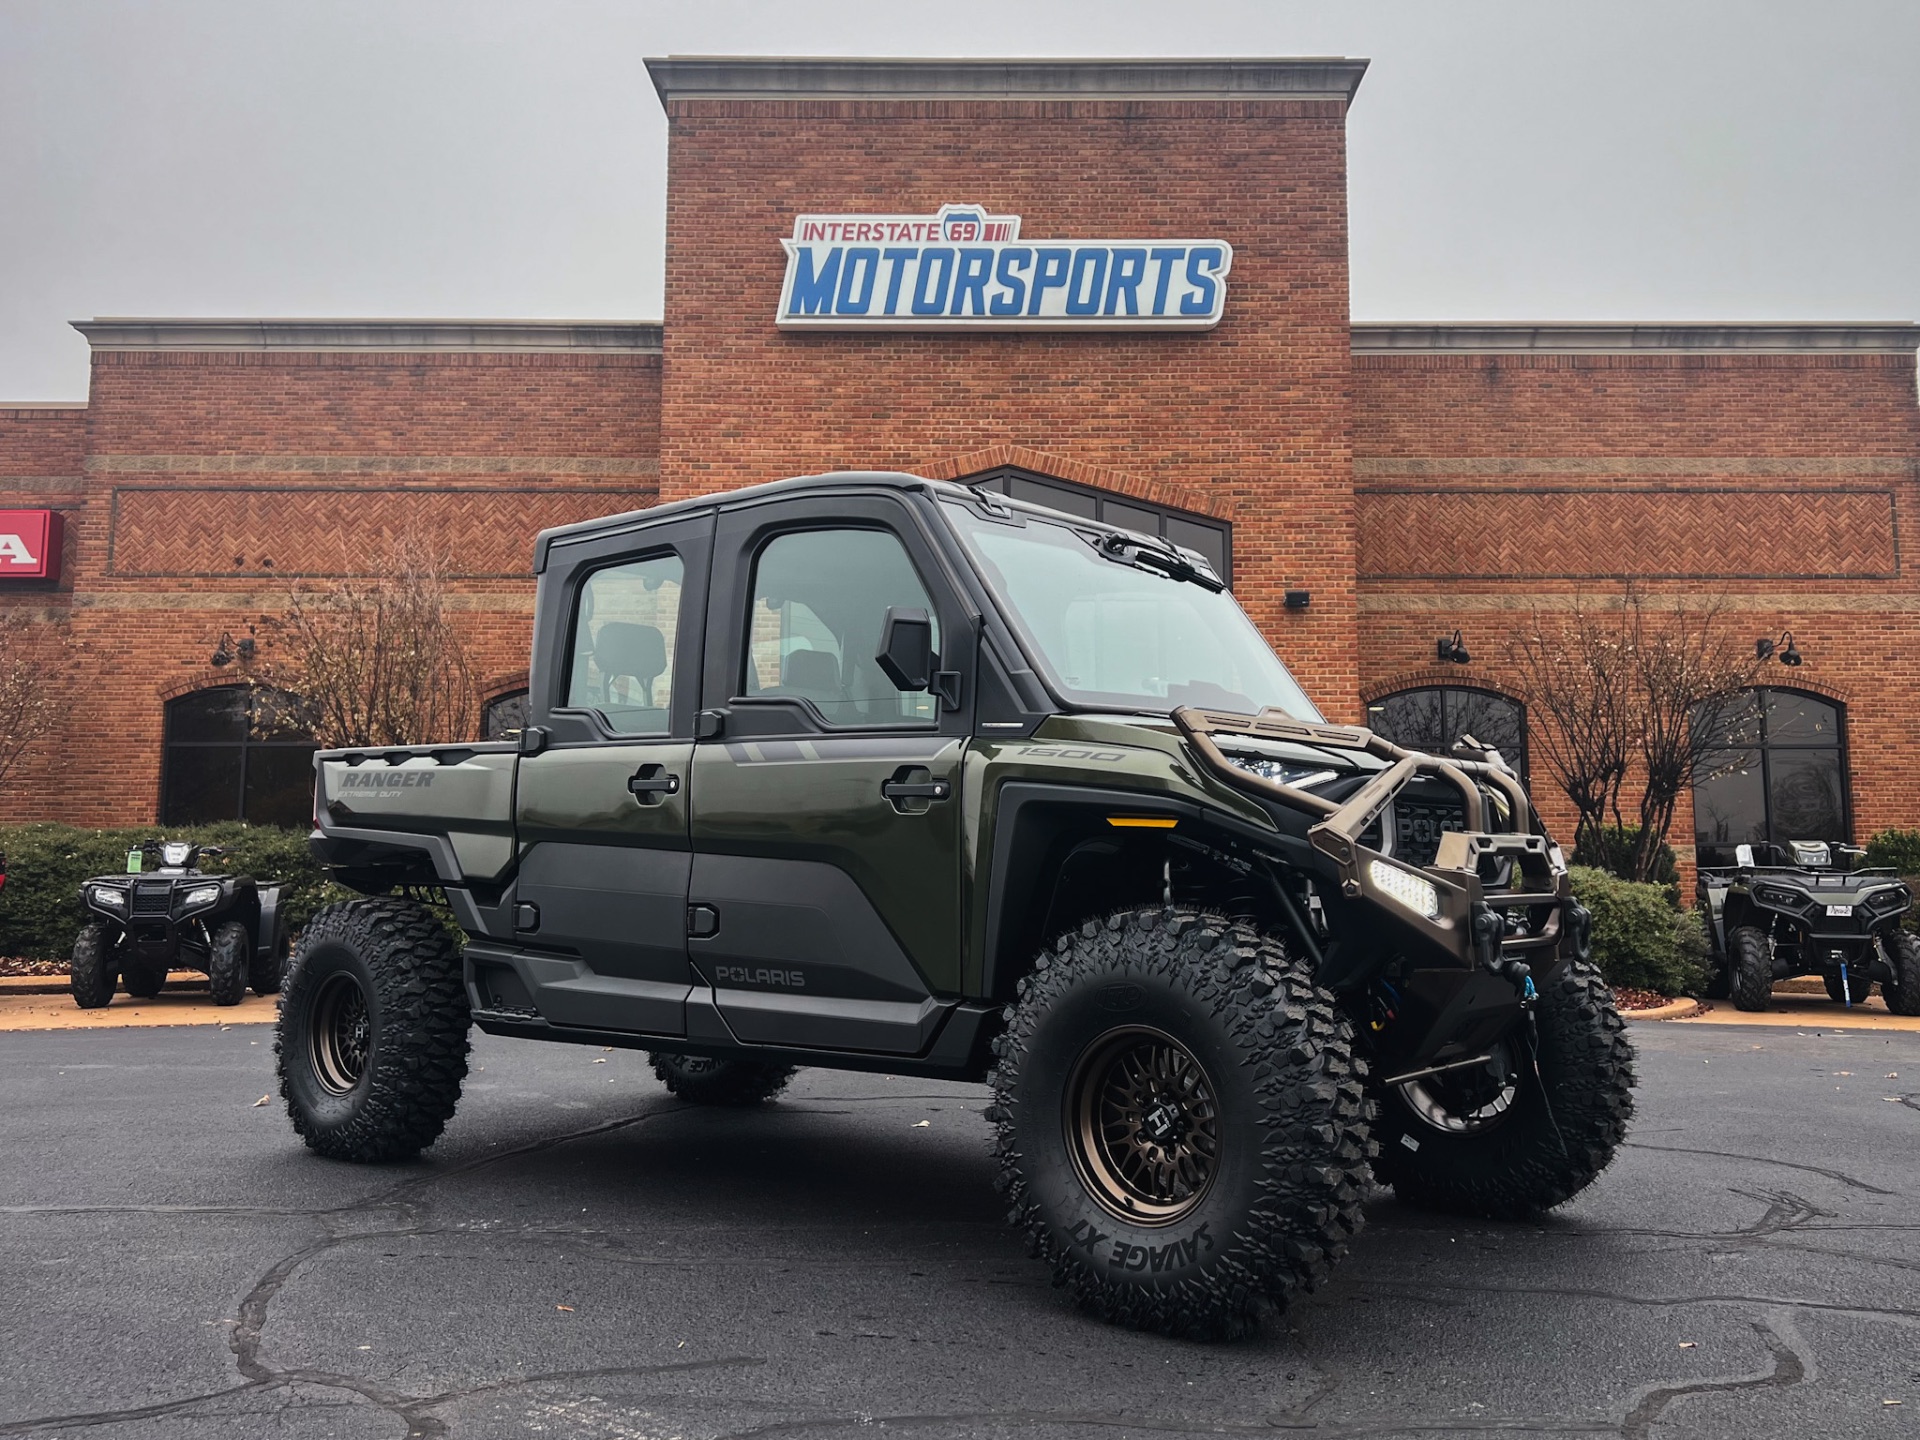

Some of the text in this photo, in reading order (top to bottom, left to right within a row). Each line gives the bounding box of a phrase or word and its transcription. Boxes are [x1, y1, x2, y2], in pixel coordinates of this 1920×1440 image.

[802, 222, 976, 242] INTERSTATE 69
[788, 247, 1222, 315] MOTORSPORTS
[1017, 747, 1126, 762] 1500
[342, 772, 435, 788] RANGER
[715, 966, 805, 987] POLARIS
[1063, 1218, 1215, 1273] SAVAGE XT
